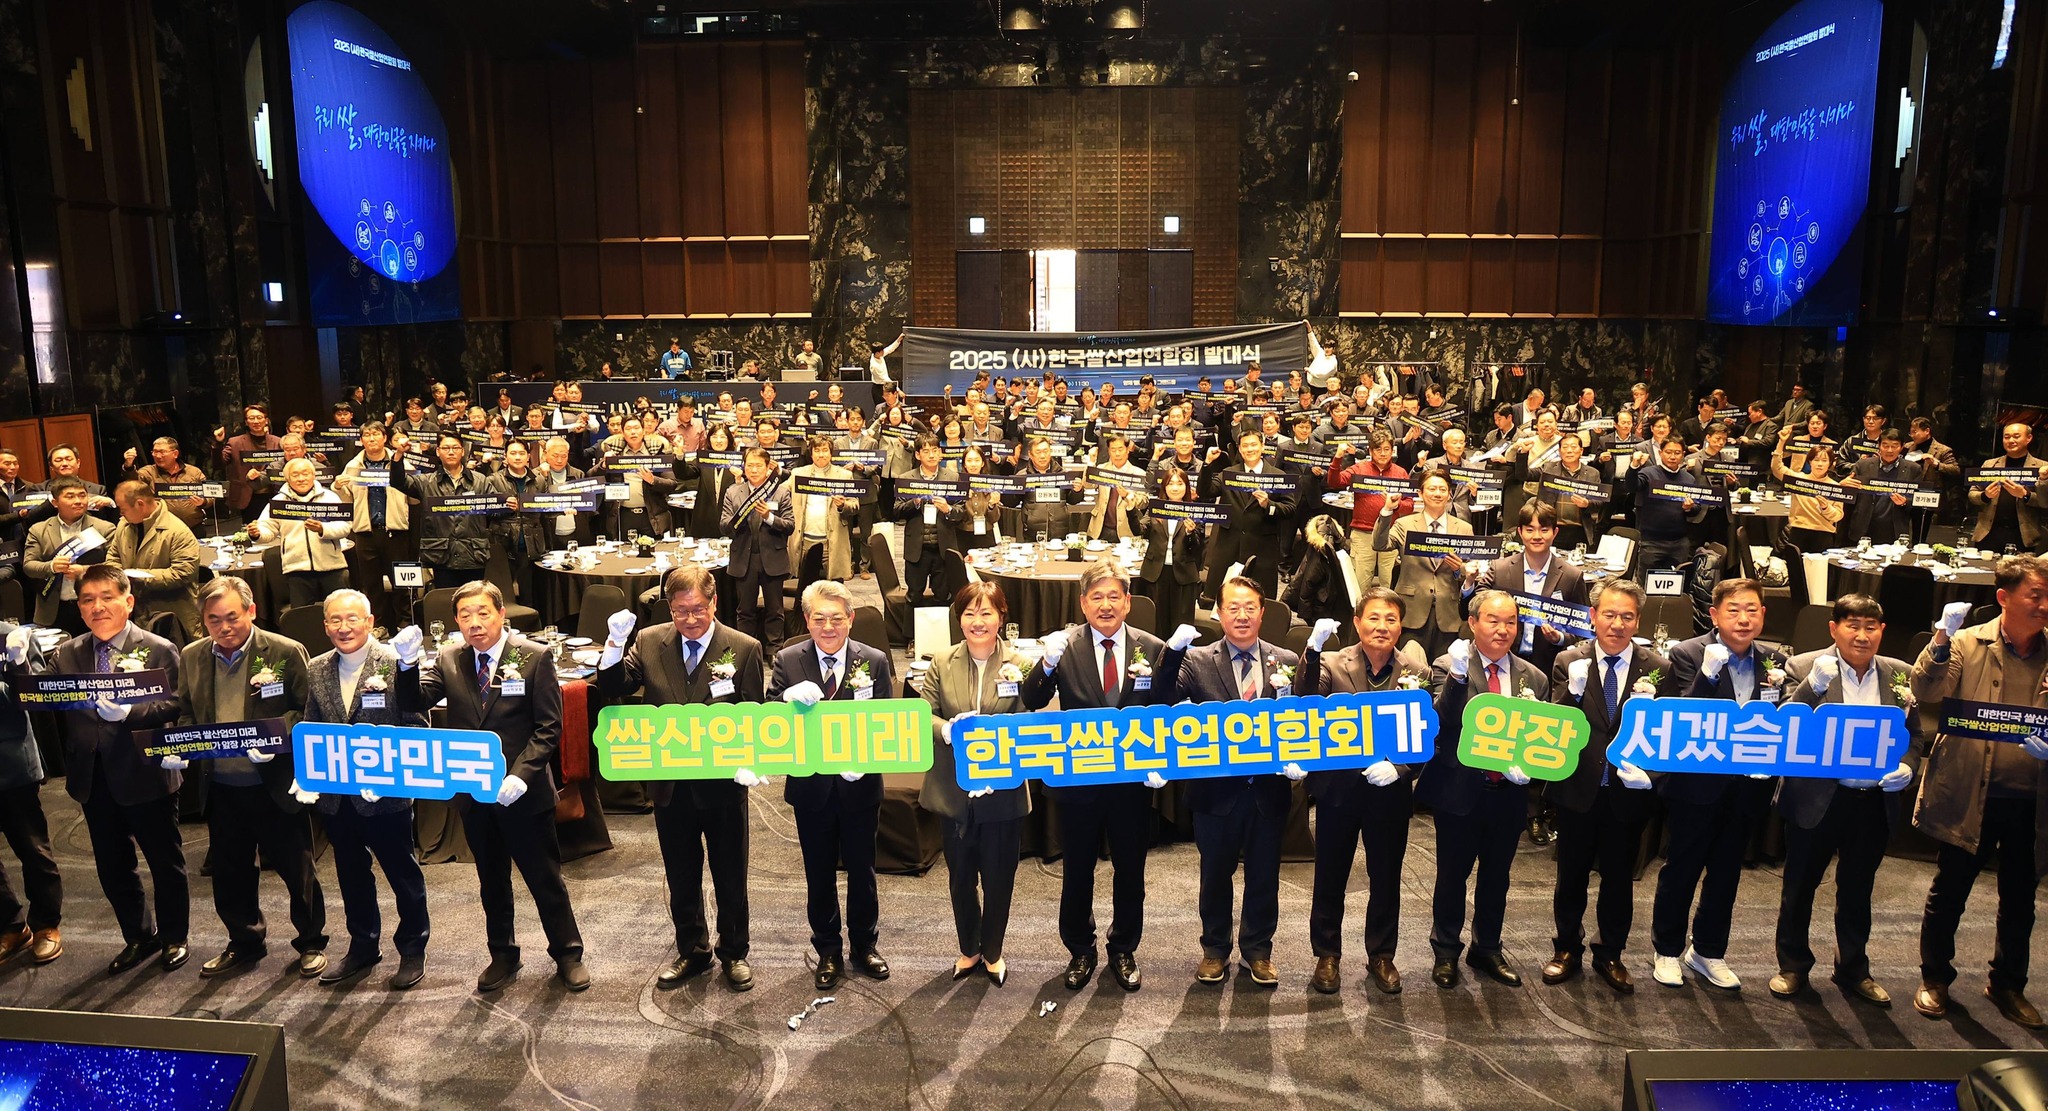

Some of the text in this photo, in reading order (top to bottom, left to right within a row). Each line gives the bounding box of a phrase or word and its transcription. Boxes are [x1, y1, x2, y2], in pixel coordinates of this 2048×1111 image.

[950, 344, 1260, 371] 2025 (사)한국쌀산업연합회 발대식
[400, 572, 416, 581] VIP
[1654, 580, 1674, 589] VIP
[1543, 602, 1570, 616] 쌀산업의
[1572, 609, 1587, 619] 미래
[1553, 616, 1568, 625] 앞장
[1568, 619, 1595, 632] 서겠습니
[19, 691, 96, 702] 한국쌀산업연합회가
[117, 685, 163, 699] 서겠습니다
[39, 678, 135, 691] 대한민국 쌀산업의 미래
[1978, 708, 2022, 722] 대한민국
[165, 727, 257, 743] 대한민국 쌀산업의 미래
[1948, 717, 2042, 736] 한국쌀산업연합회가
[144, 736, 283, 756] 한국쌀산업연합회가 앞장 서겠습니다
[605, 709, 922, 770] 쌀산업의 미래
[963, 701, 1427, 780] 한국쌀산업연합회가
[1471, 706, 1578, 769] 앞장
[1621, 710, 1896, 769] 서겠습니다
[305, 732, 494, 792] 대한민국
